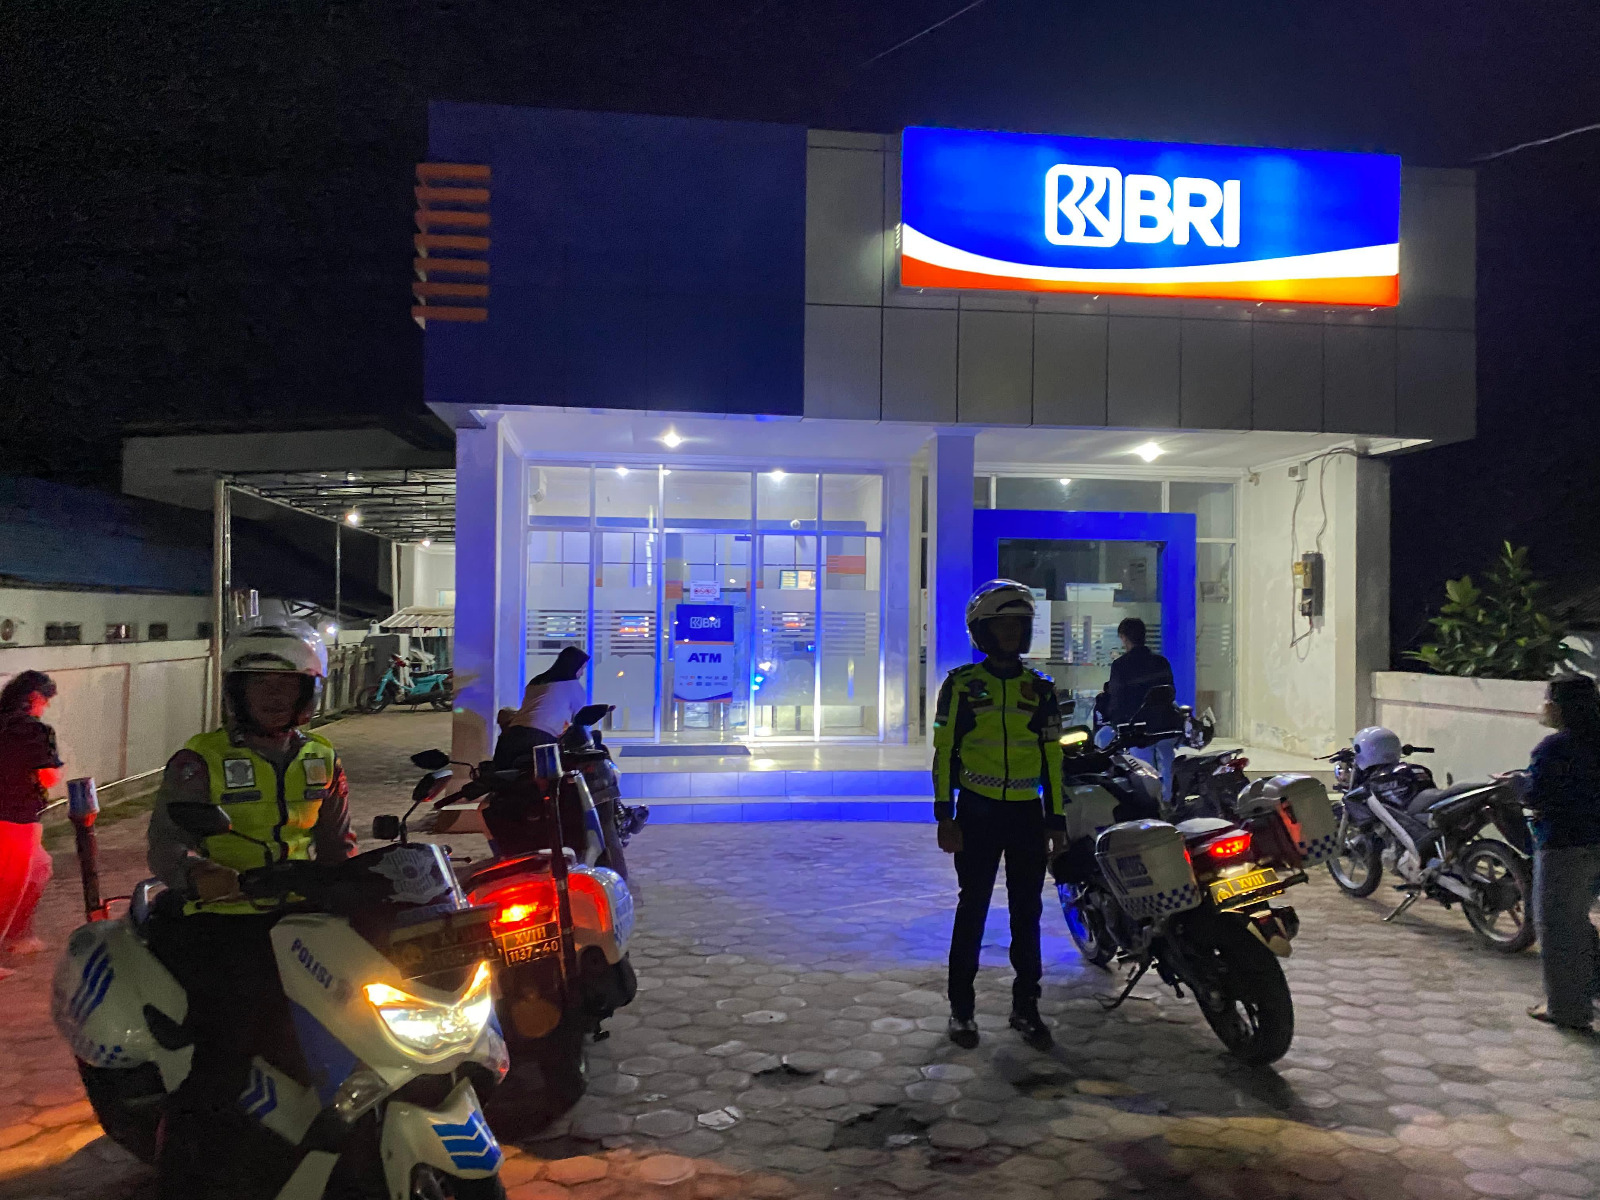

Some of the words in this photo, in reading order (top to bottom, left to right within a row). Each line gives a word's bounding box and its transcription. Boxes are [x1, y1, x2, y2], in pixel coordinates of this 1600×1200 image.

[1124, 173, 1242, 248] BRI
[702, 617, 721, 628] BRI
[687, 653, 722, 663] ATM
[291, 937, 333, 989] POLISI
